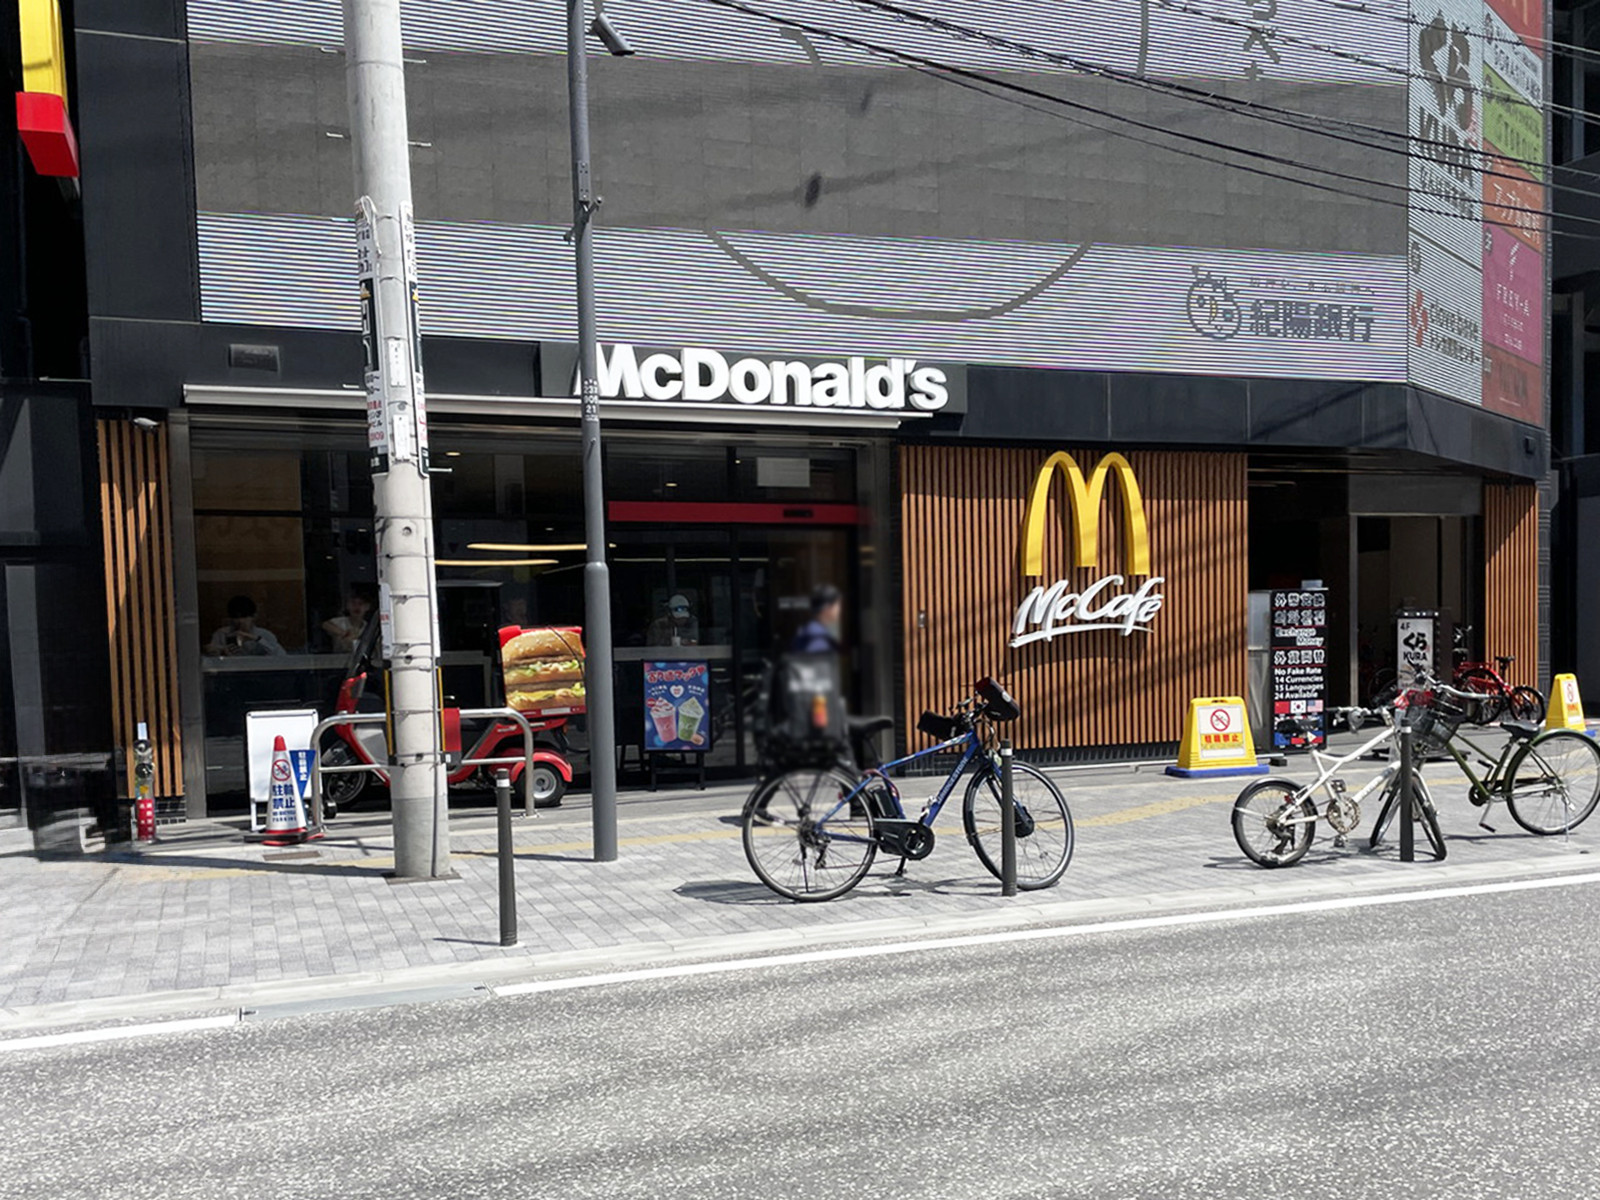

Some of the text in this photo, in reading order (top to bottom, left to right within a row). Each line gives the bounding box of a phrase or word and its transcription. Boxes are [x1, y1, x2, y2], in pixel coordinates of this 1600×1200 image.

[573, 342, 949, 411] McDonald's
[1011, 574, 1166, 644] McCafé
[1274, 626, 1317, 637] Exchange
[1296, 636, 1325, 647] Money
[1402, 631, 1428, 651] くら
[1403, 651, 1428, 661] KURA
[1274, 667, 1322, 676] No Fake Rate
[1285, 675, 1324, 683] Currencies
[1285, 683, 1324, 693] Languages
[1285, 691, 1318, 700] Available
[272, 797, 295, 809] 禁止
